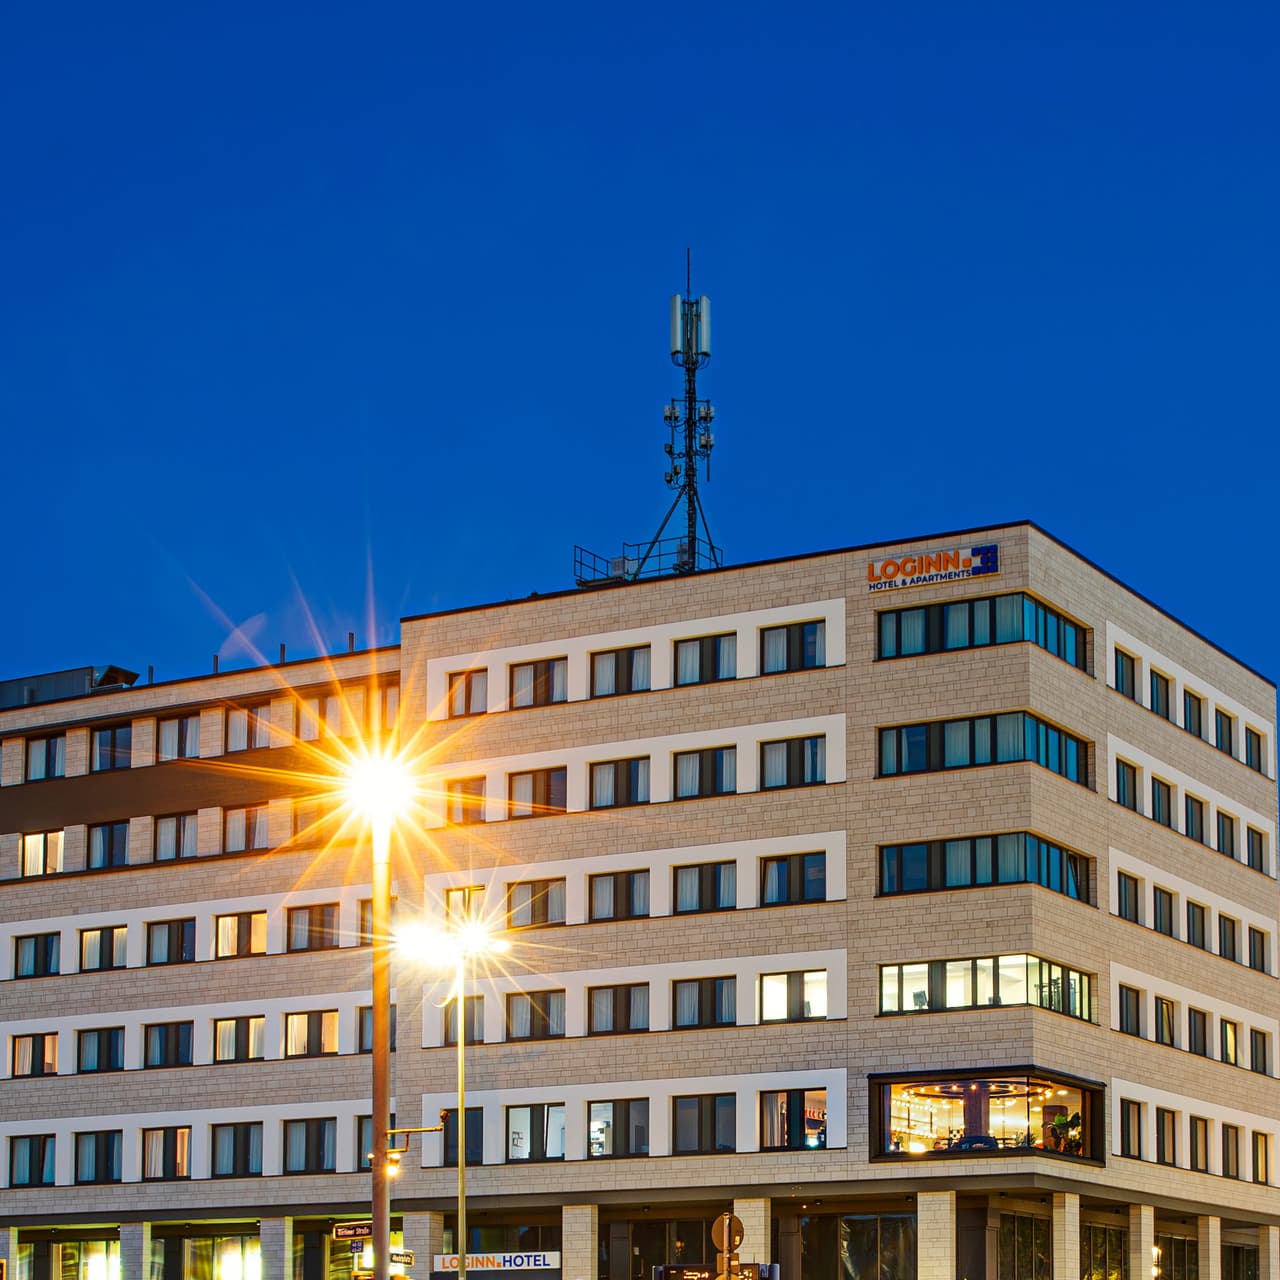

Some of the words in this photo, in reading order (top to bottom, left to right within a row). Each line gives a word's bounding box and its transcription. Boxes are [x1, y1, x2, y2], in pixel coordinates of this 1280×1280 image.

[868, 579, 899, 591] HOTEL
[901, 578, 908, 586] &
[909, 569, 972, 586] APARTMENTS
[502, 1254, 551, 1268] HOTEL
